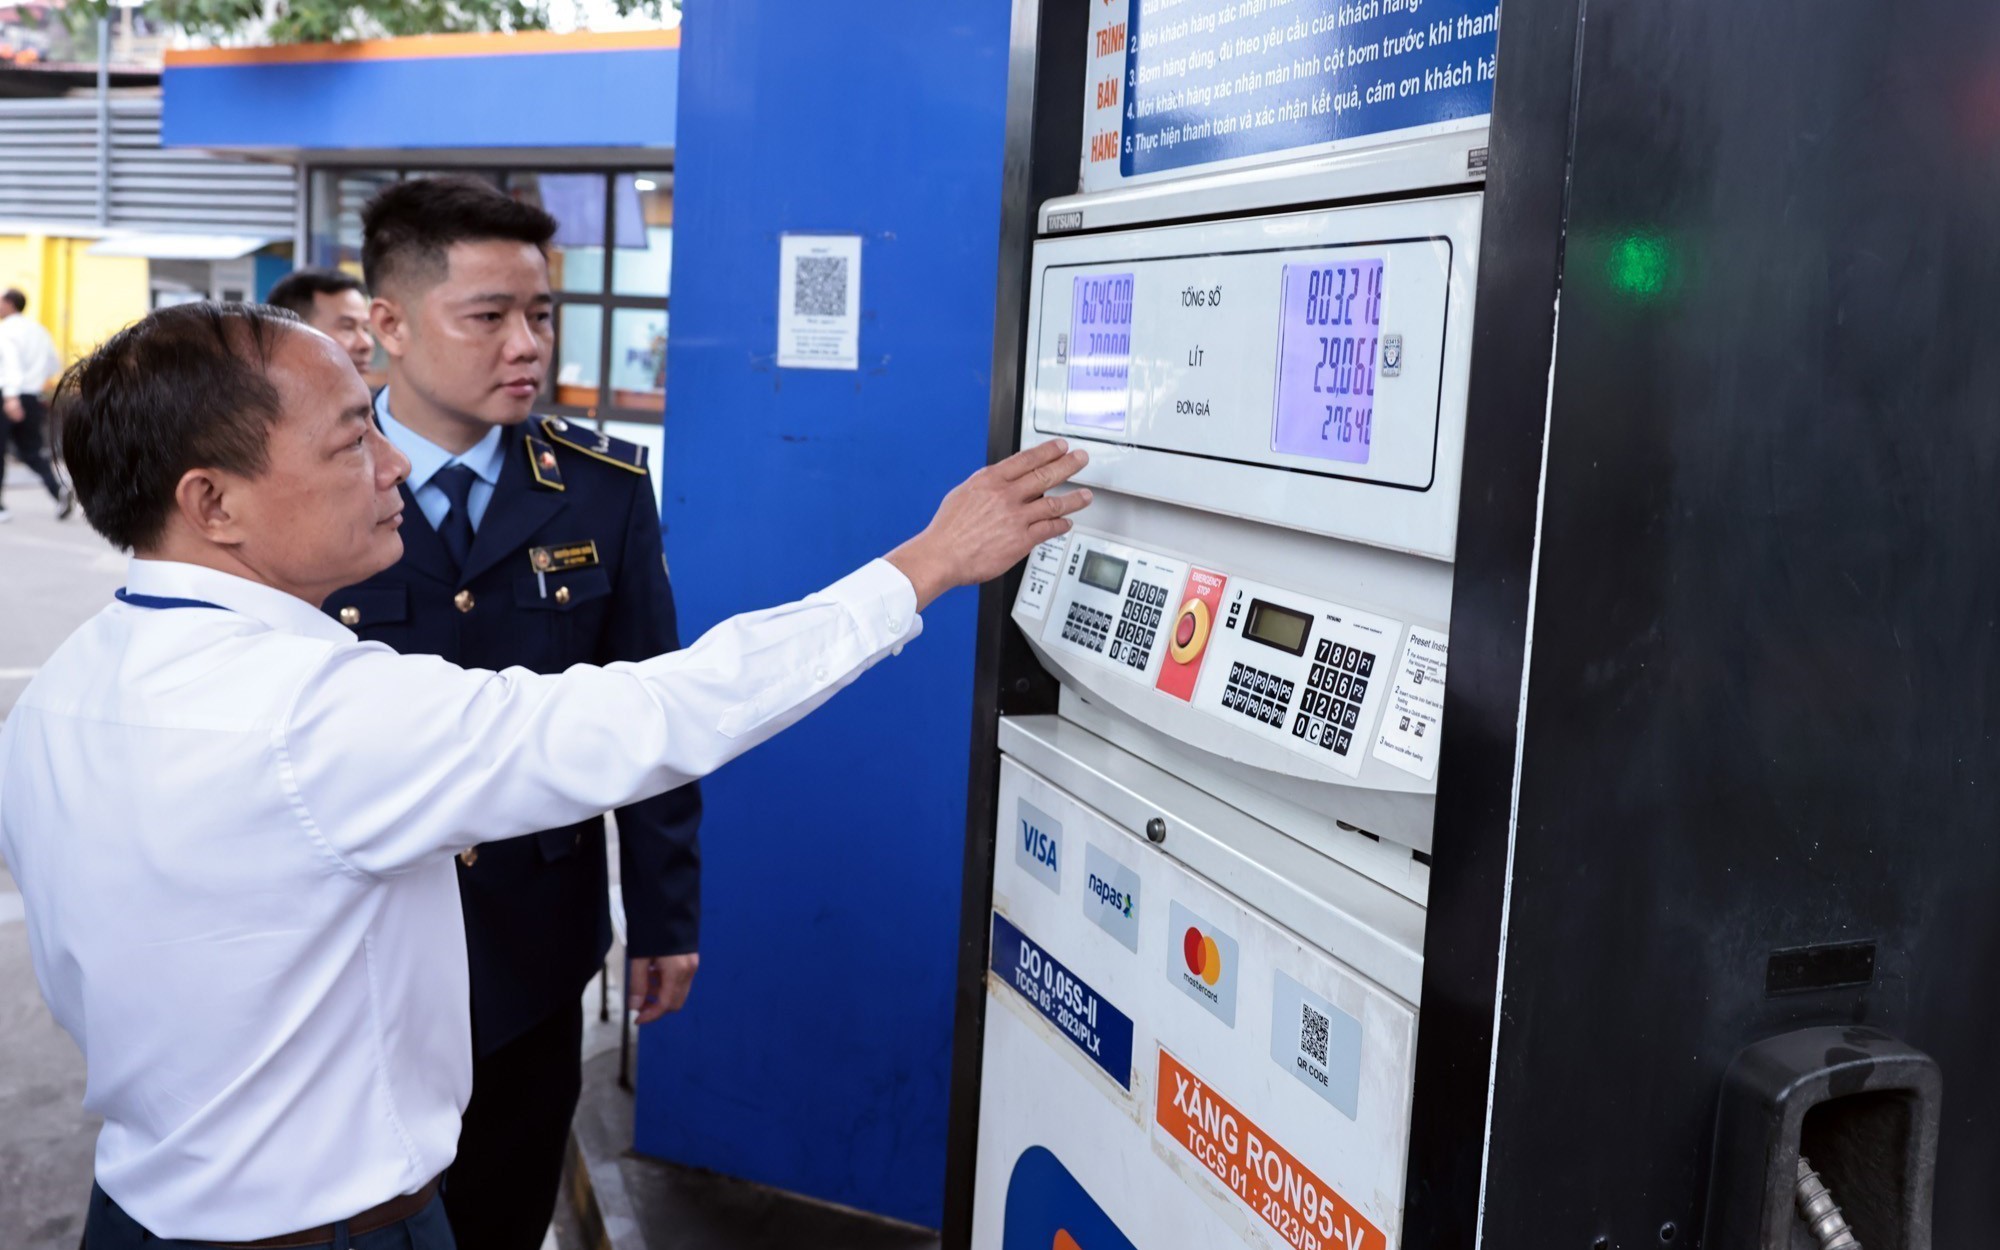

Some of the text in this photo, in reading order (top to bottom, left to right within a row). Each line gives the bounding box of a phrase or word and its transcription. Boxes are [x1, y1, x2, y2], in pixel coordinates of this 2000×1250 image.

[1096, 21, 1125, 58] TRÌNH
[1128, 69, 1137, 87] 3.
[1163, 56, 1186, 77] hàng
[1188, 48, 1216, 70] đúng,
[1221, 39, 1233, 61] đủ
[1236, 36, 1260, 57] theo
[1262, 26, 1283, 55] yêu
[1287, 15, 1308, 42] cầu
[1312, 10, 1334, 35] của
[1338, 0, 1378, 28] khách
[1130, 36, 1139, 53] 2.
[1141, 30, 1158, 50] Mời
[1160, 20, 1188, 43] khách
[1191, 12, 1215, 32] hàng
[1219, 4, 1236, 24] xác
[1127, 102, 1135, 119] 4.
[1137, 97, 1155, 118] Mời
[1156, 90, 1184, 113] khách
[1187, 83, 1211, 106] hàng
[1213, 78, 1232, 99] xác
[1235, 70, 1262, 96] nhận
[1265, 63, 1290, 88] màn
[1293, 54, 1320, 80] hình
[1324, 48, 1345, 76] cột
[1348, 43, 1379, 67] bơm
[1383, 28, 1425, 58] trước
[1429, 18, 1453, 47] khi
[1097, 74, 1118, 110] BÁN
[1125, 136, 1133, 154] 5.
[1135, 132, 1159, 154] Thực
[1160, 125, 1180, 150] hiện
[1183, 119, 1210, 143] thanh
[1213, 114, 1236, 136] toán
[1240, 109, 1252, 130] và
[1255, 104, 1275, 128] xác
[1278, 97, 1307, 124] nhận
[1311, 88, 1331, 116] kết
[1334, 84, 1362, 116] quả,
[1366, 79, 1396, 105] cám
[1400, 76, 1420, 98] ơn
[1424, 60, 1472, 92] khách
[1091, 128, 1118, 163] HÀNG
[1048, 213, 1081, 229] TATSUNO
[1081, 279, 1133, 325] 604600
[1181, 285, 1222, 307] TỔNG SỐ
[1189, 344, 1204, 367] LÍT
[1176, 398, 1210, 416] ĐƠN GIÁ
[1131, 582, 1165, 603] 7 8 9 F1
[1192, 572, 1222, 588] EMERGENCY
[1197, 585, 1210, 596] STOP
[1124, 602, 1159, 624] 4 5 6 F2
[1120, 623, 1153, 645] 1 2 3 F3
[1410, 634, 1431, 648] Preset
[1112, 643, 1146, 666] 0 C F4
[1320, 642, 1370, 672] 7 8 9 F1
[1231, 666, 1292, 699] P1 P2 P3 P4 P5
[1312, 668, 1363, 698] 4 5 6 F2
[1395, 685, 1400, 693] 2
[1224, 689, 1285, 724] P6 P7 P8 P9 P10
[1306, 693, 1356, 724] 1 2 3 F3
[1296, 717, 1347, 749] 0 C F4
[1380, 736, 1384, 744] 3
[1021, 819, 1057, 872] VISA
[1088, 873, 1122, 911] napas
[1021, 940, 1097, 1028] DO 0,05S-II
[1183, 973, 1218, 1003] mastercard
[1015, 967, 1039, 1001] TCCS
[1040, 989, 1051, 1012] 03
[1057, 1005, 1100, 1056] 2023/PLX
[1296, 1056, 1329, 1087] QR CODE
[1173, 1071, 1364, 1250] XĂNG RON95-V
[1187, 1124, 1227, 1178] TCCS
[1230, 1165, 1247, 1197] 01
[1262, 1192, 1330, 1250] 2023/P
